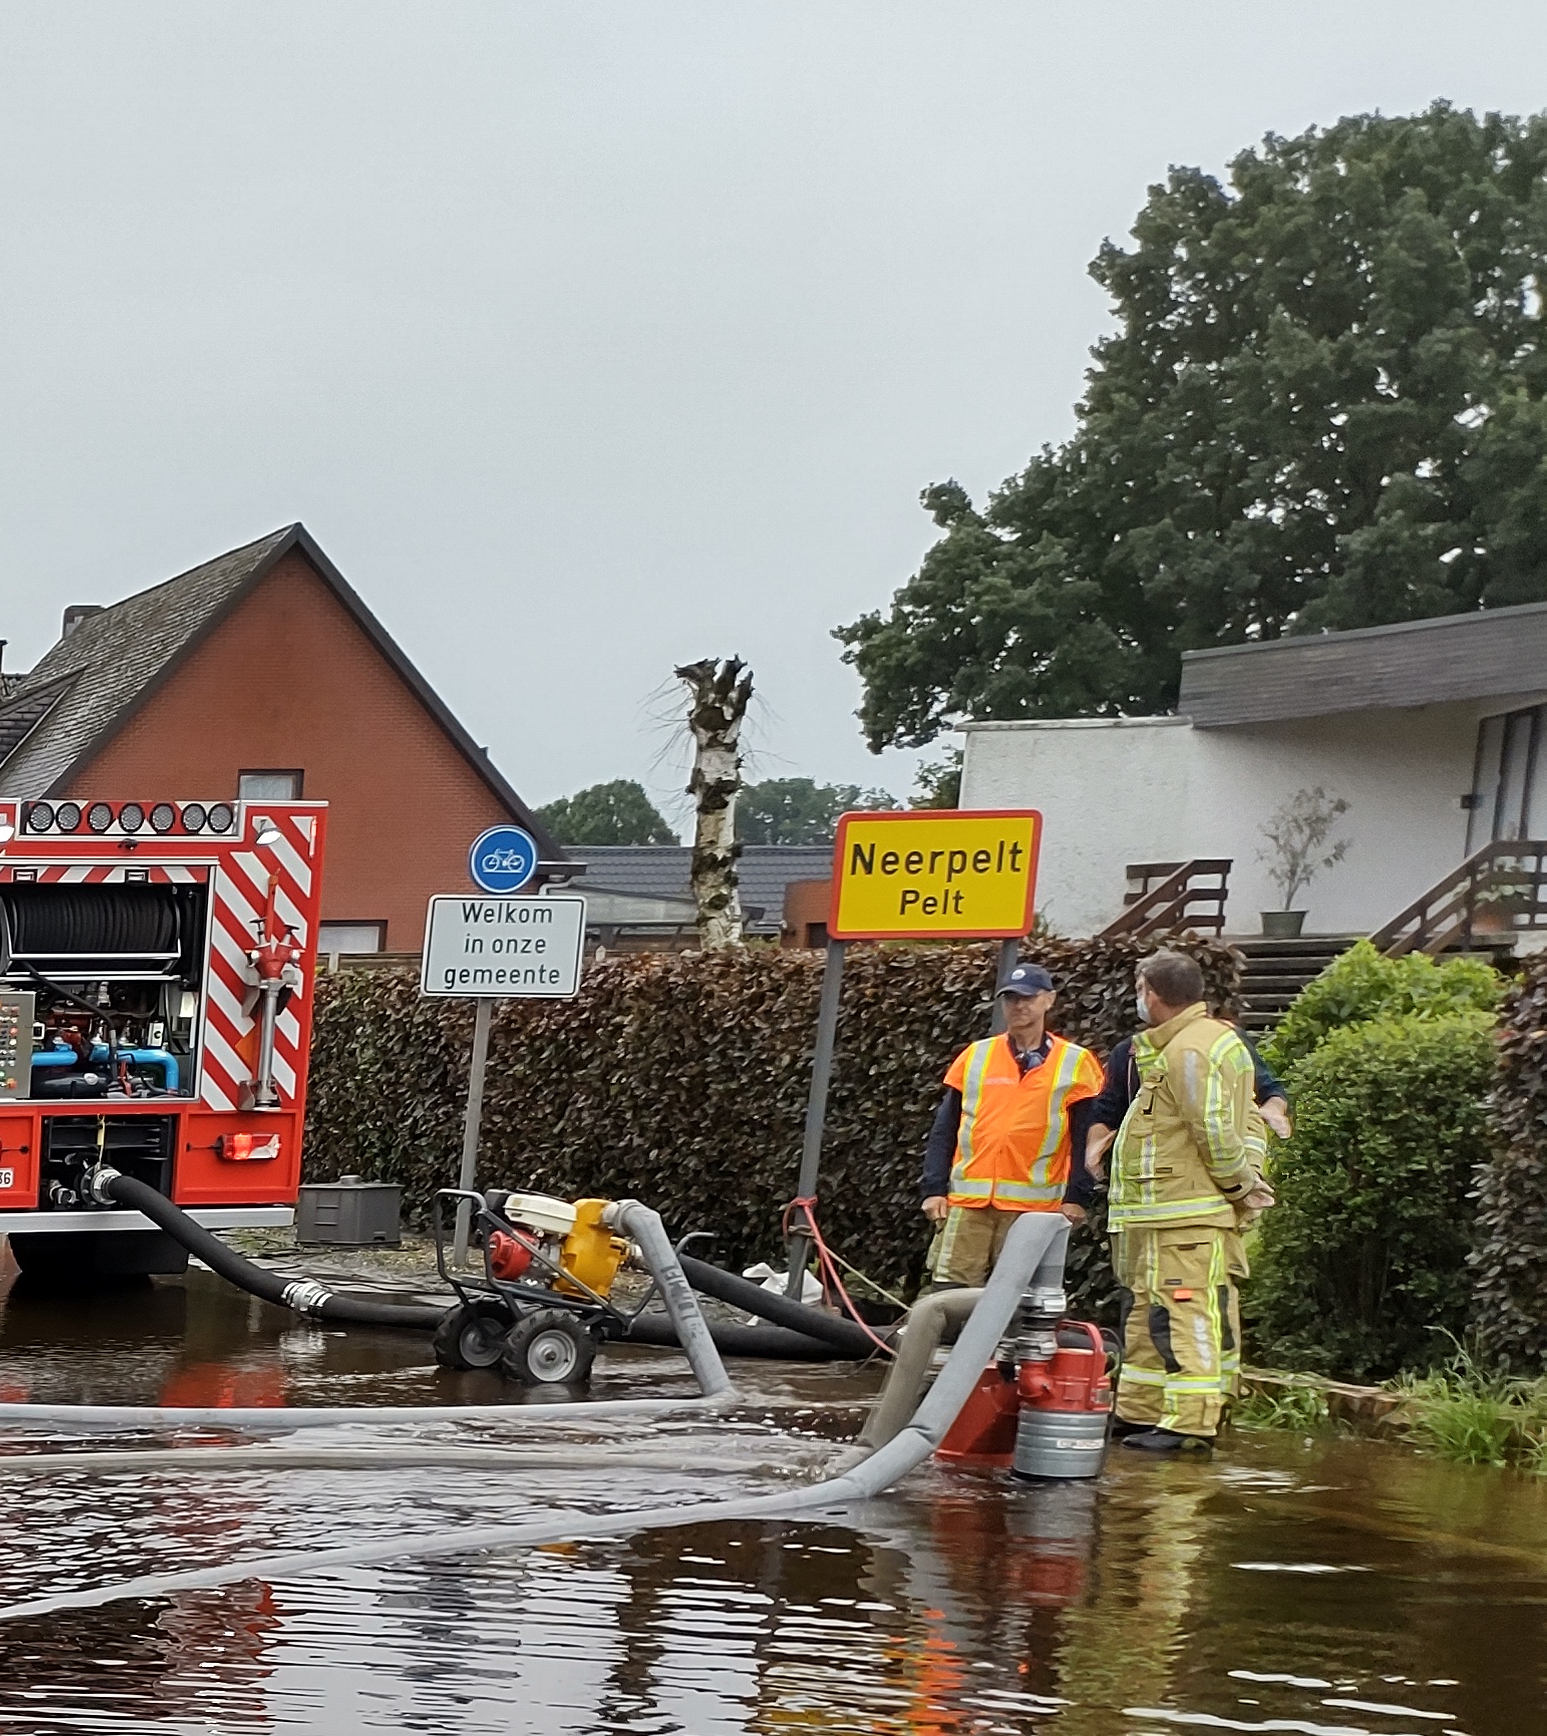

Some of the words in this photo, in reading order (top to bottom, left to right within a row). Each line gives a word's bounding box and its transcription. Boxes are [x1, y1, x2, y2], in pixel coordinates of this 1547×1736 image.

[850, 840, 1023, 883] Neerpelt
[462, 902, 553, 923] Welkom
[899, 889, 964, 915] Pelt
[464, 933, 484, 954] in
[492, 938, 547, 954] onze
[444, 964, 560, 990] gemeente
